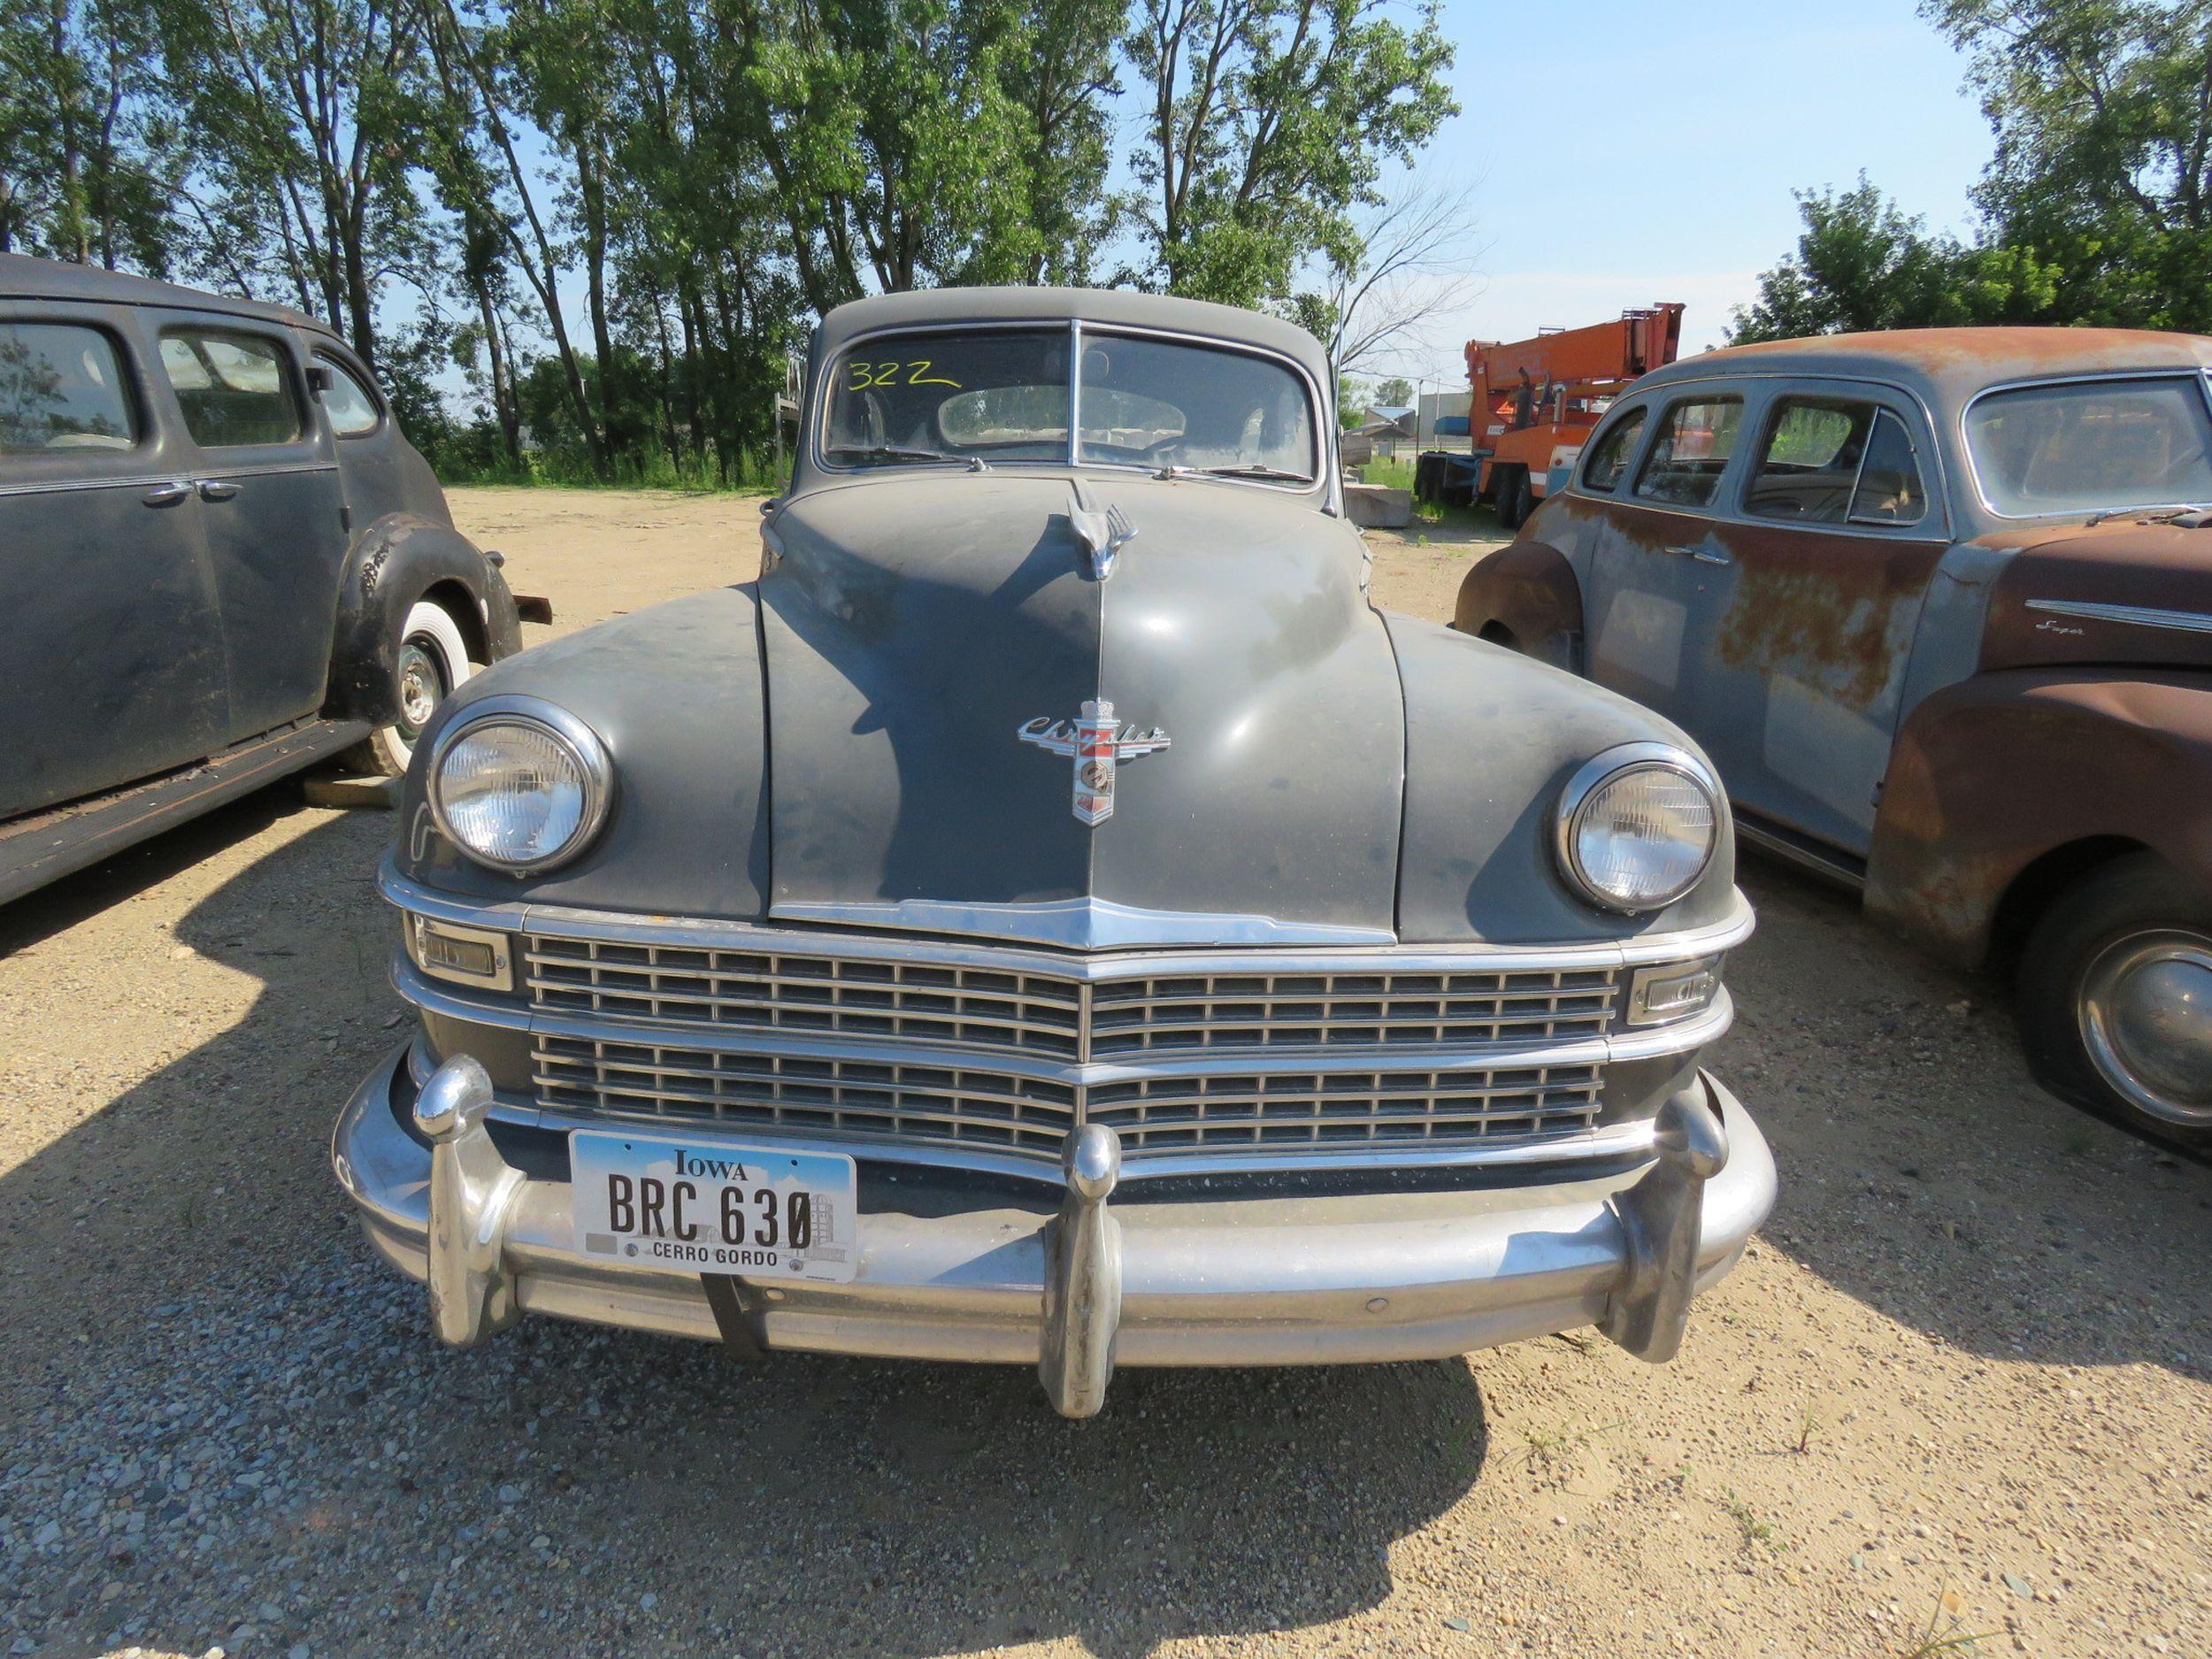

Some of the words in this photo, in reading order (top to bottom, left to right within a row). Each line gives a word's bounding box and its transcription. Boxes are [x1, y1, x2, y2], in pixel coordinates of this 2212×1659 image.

[849, 360, 963, 391] 322
[2035, 620, 2086, 636] Super
[608, 1173, 698, 1241] BRC
[720, 1186, 811, 1249] 630
[653, 1241, 709, 1263] CERRO
[715, 1248, 778, 1267] GORDO
